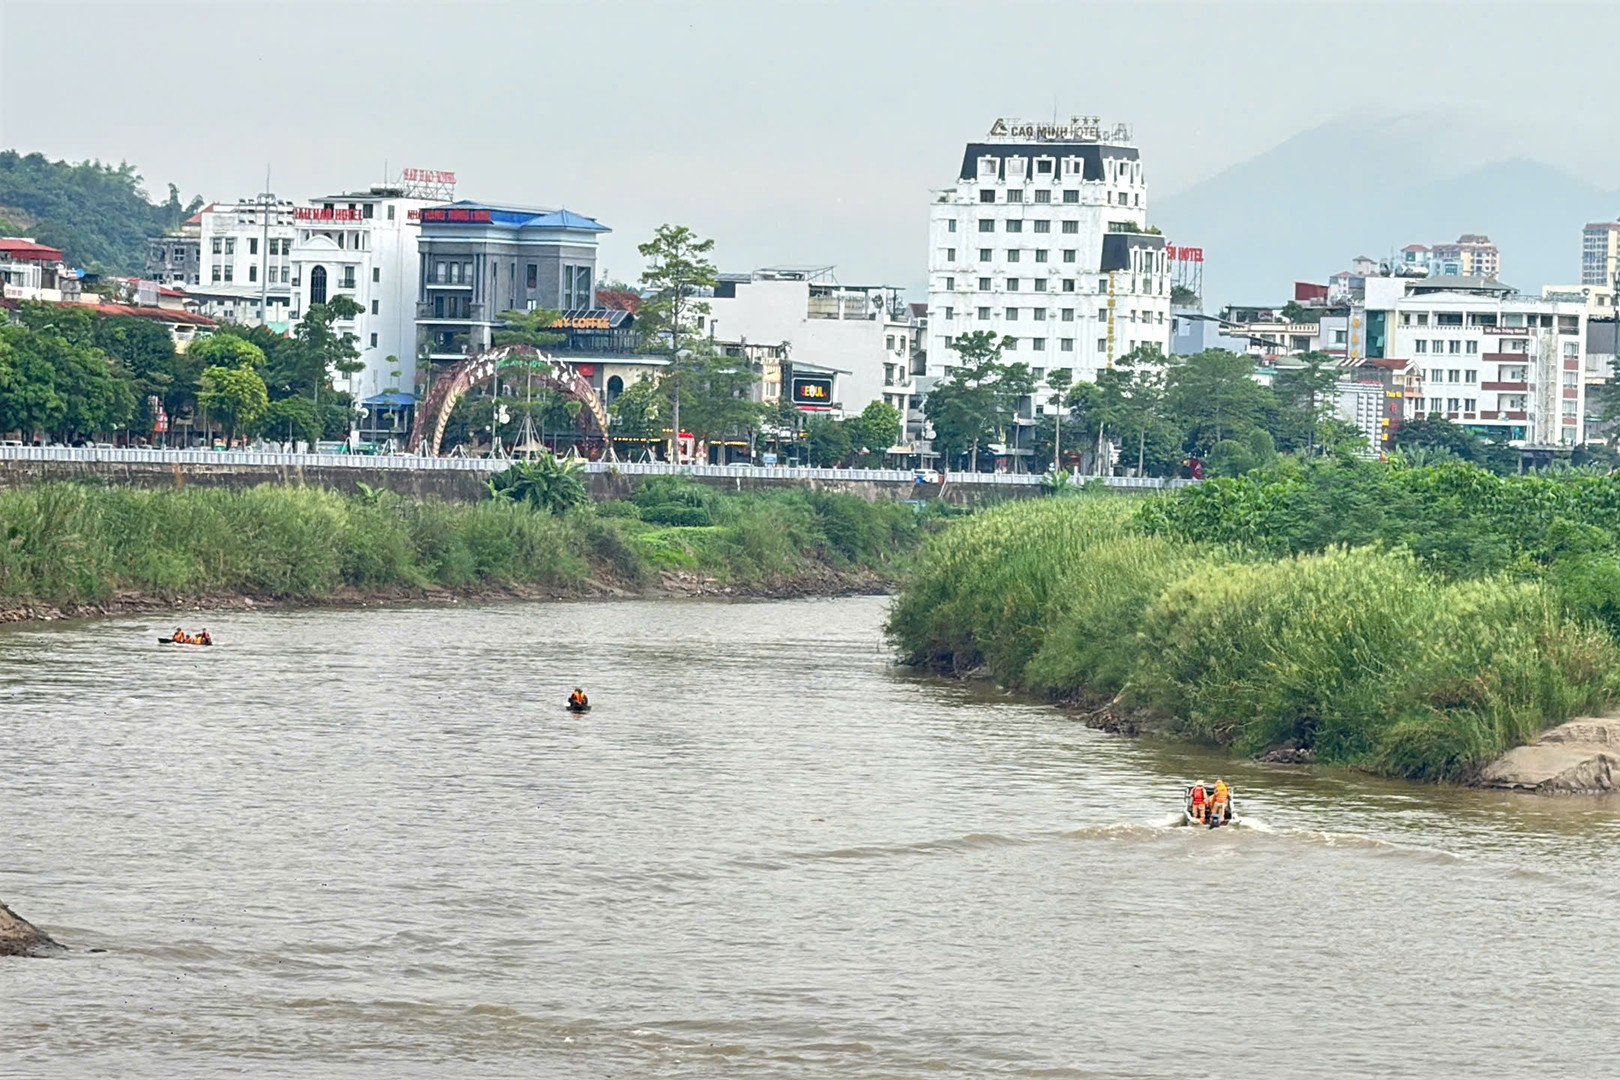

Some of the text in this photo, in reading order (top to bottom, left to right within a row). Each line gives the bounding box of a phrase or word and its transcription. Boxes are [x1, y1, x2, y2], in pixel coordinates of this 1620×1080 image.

[1011, 126, 1033, 137] CAO
[1036, 126, 1067, 138] MINH
[1070, 125, 1099, 138] HOTEL
[1178, 246, 1204, 262] HOTEL
[572, 317, 611, 329] COFFEE
[801, 384, 824, 398] SEOUL
